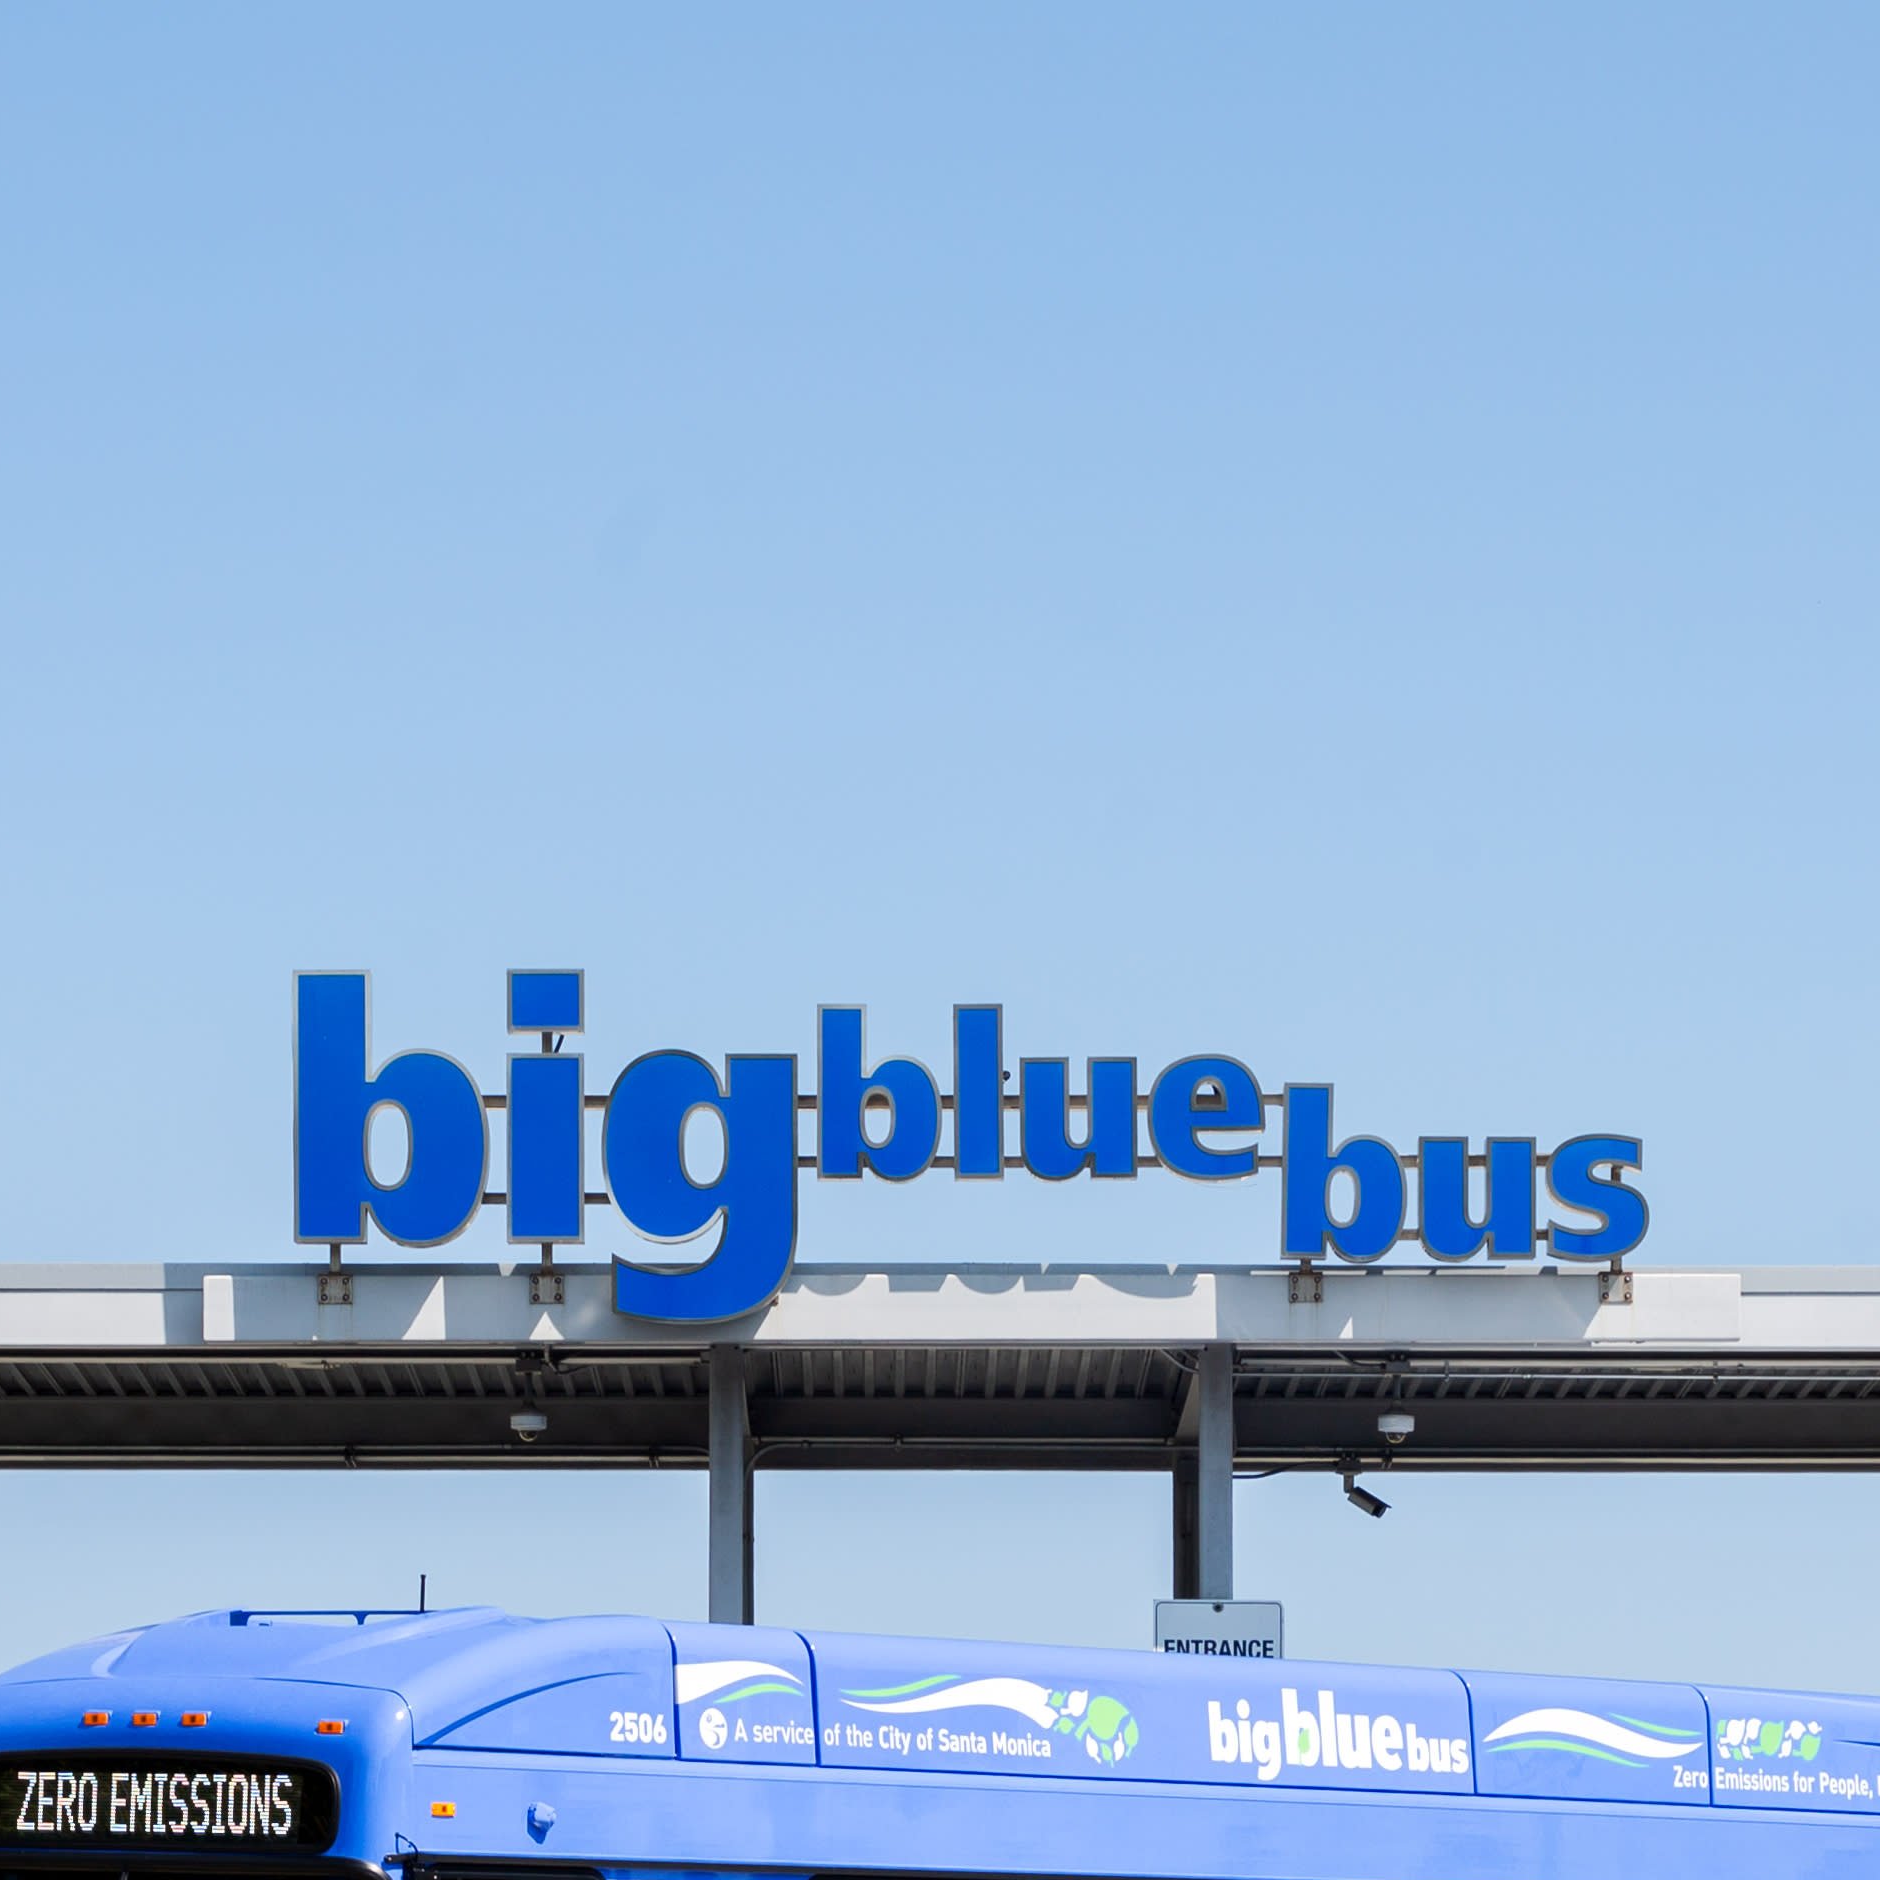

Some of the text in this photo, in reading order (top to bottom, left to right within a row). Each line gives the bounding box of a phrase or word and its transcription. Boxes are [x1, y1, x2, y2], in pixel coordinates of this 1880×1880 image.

[292, 967, 1649, 1326] big blue bus
[1164, 1639, 1274, 1658] ENTRANCE
[610, 1711, 667, 1744] 2506
[734, 1718, 1051, 1758] A service of the City of Santa Monica
[1207, 1688, 1469, 1781] big blue bus
[1673, 1765, 1708, 1788] Zero
[1715, 1767, 1790, 1792] Emissions
[1793, 1770, 1815, 1793] for
[1819, 1771, 1873, 1800] People,
[16, 1771, 293, 1835] ZERO EMISSIONS
